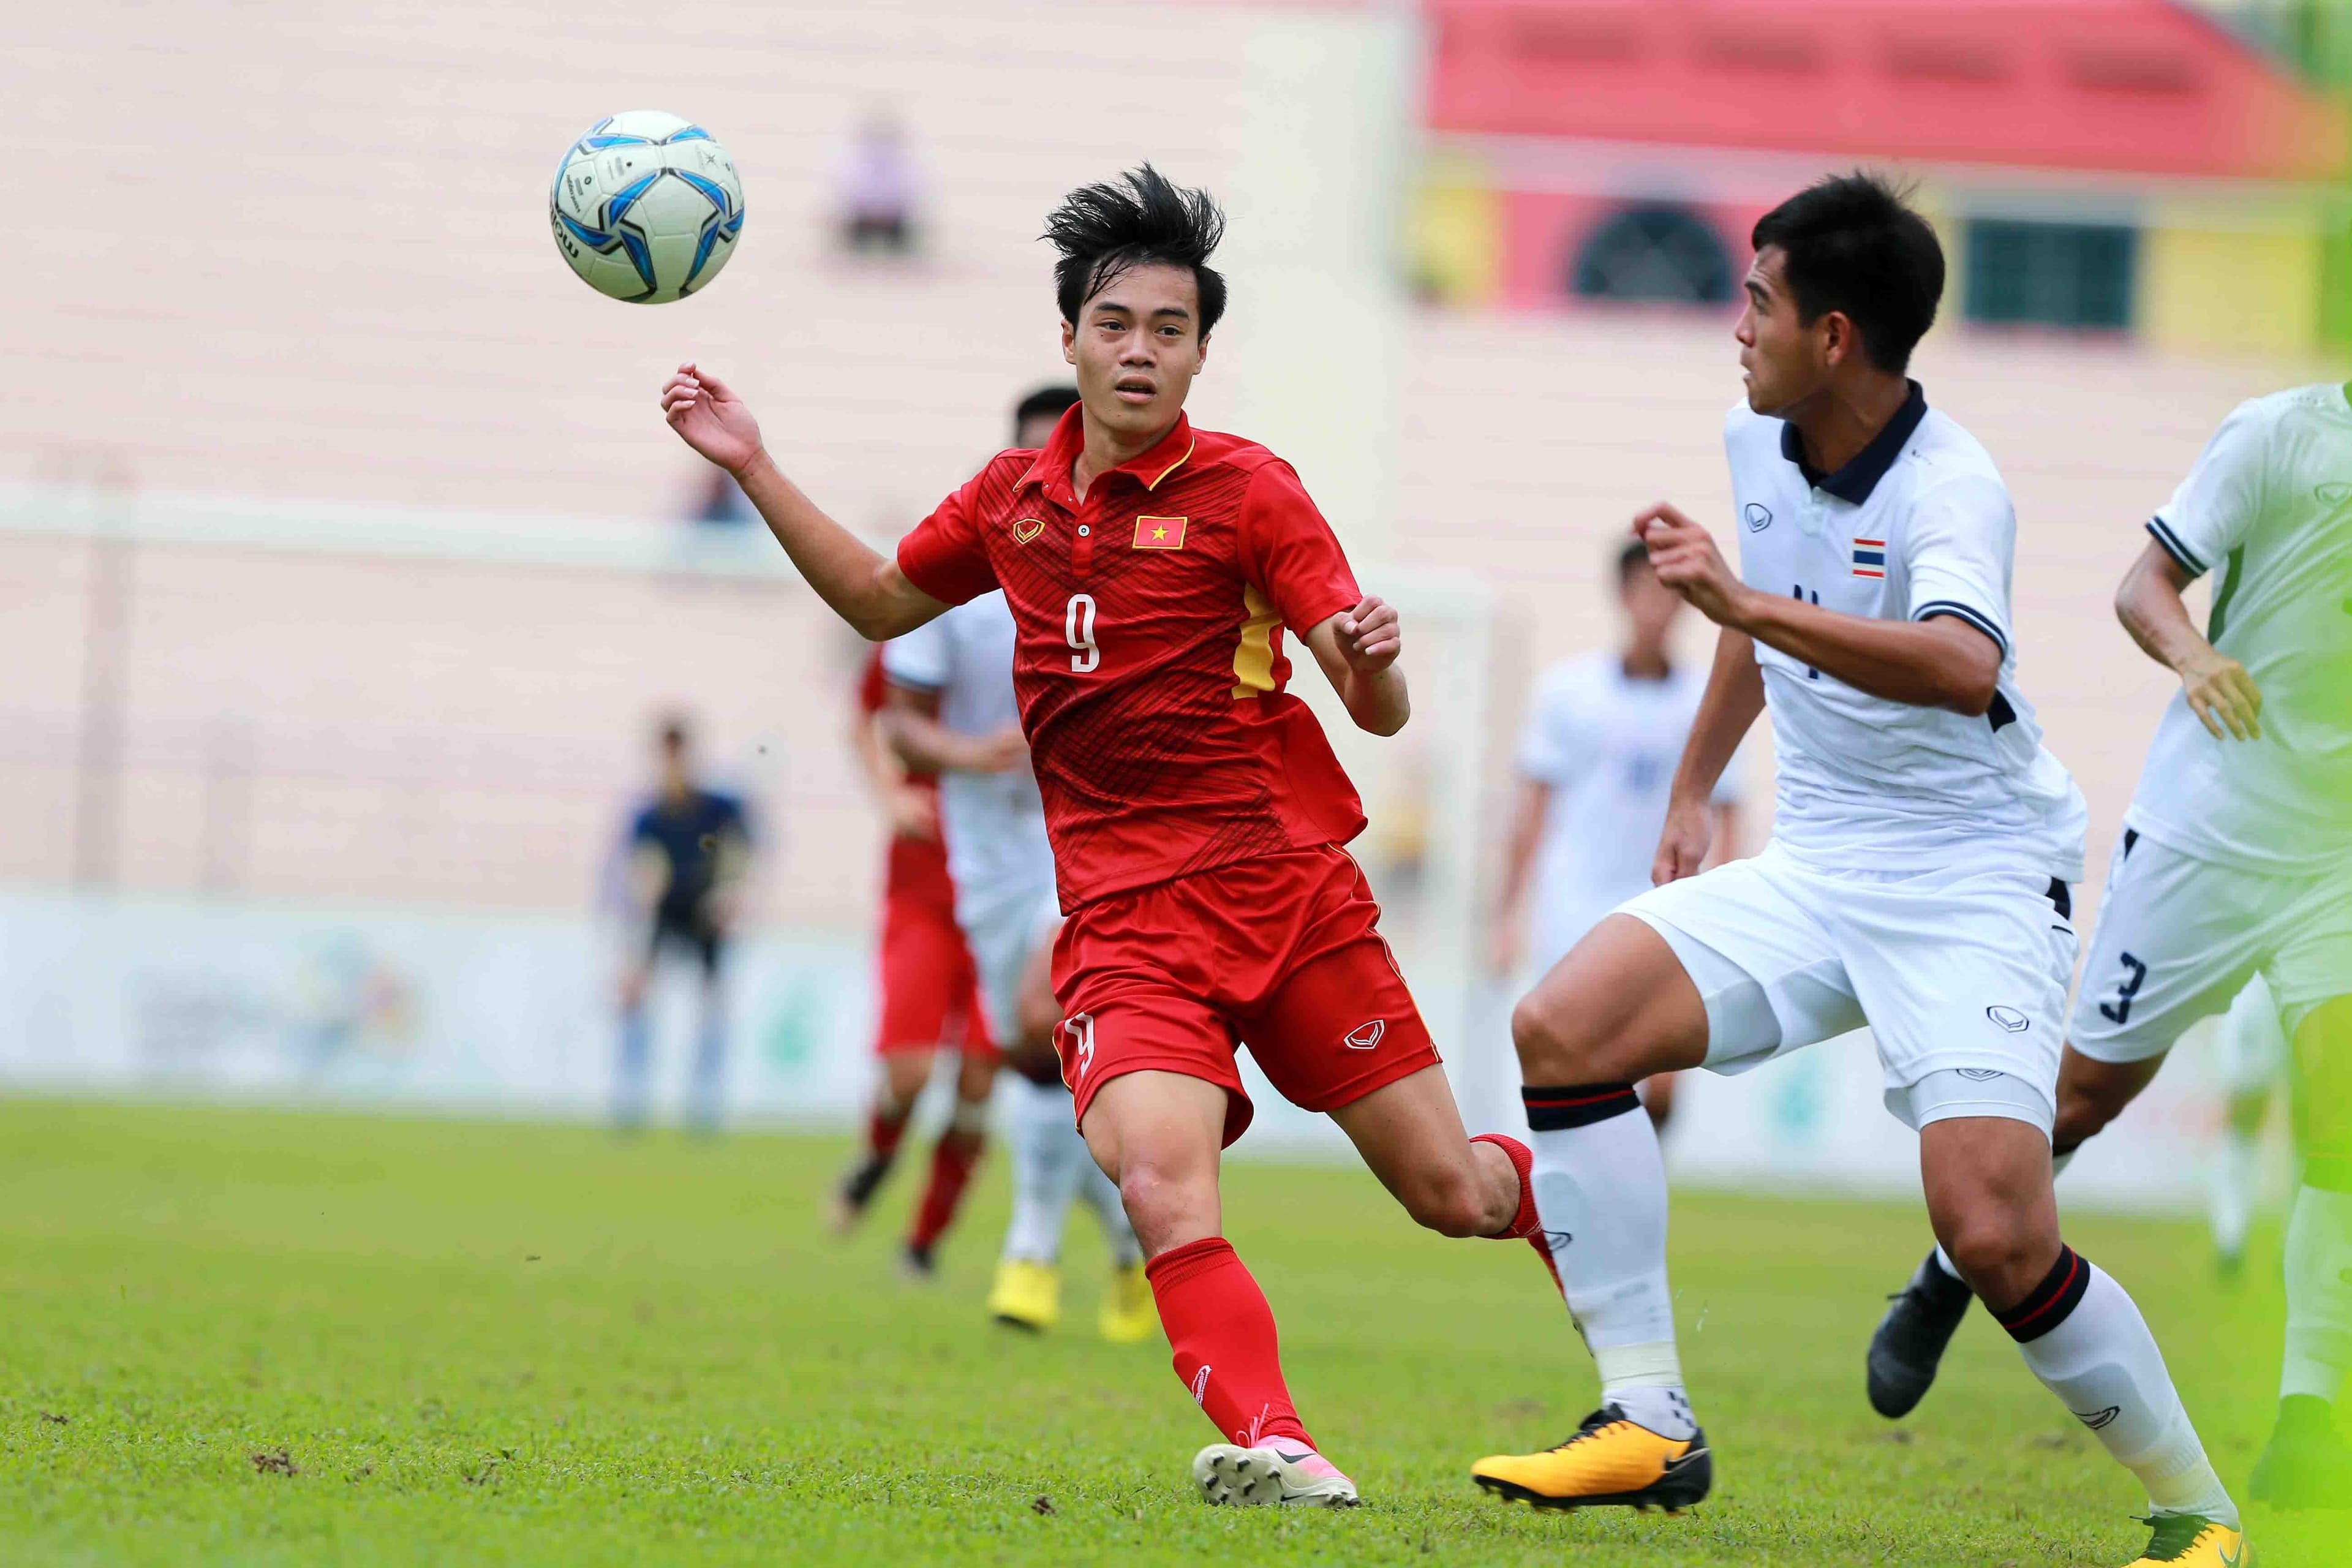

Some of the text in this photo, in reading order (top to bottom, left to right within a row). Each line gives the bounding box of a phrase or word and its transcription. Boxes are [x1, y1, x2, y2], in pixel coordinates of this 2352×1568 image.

[1066, 594, 1100, 673] 9
[2099, 952, 2147, 1024] 3
[1064, 1012, 1095, 1079] 9
